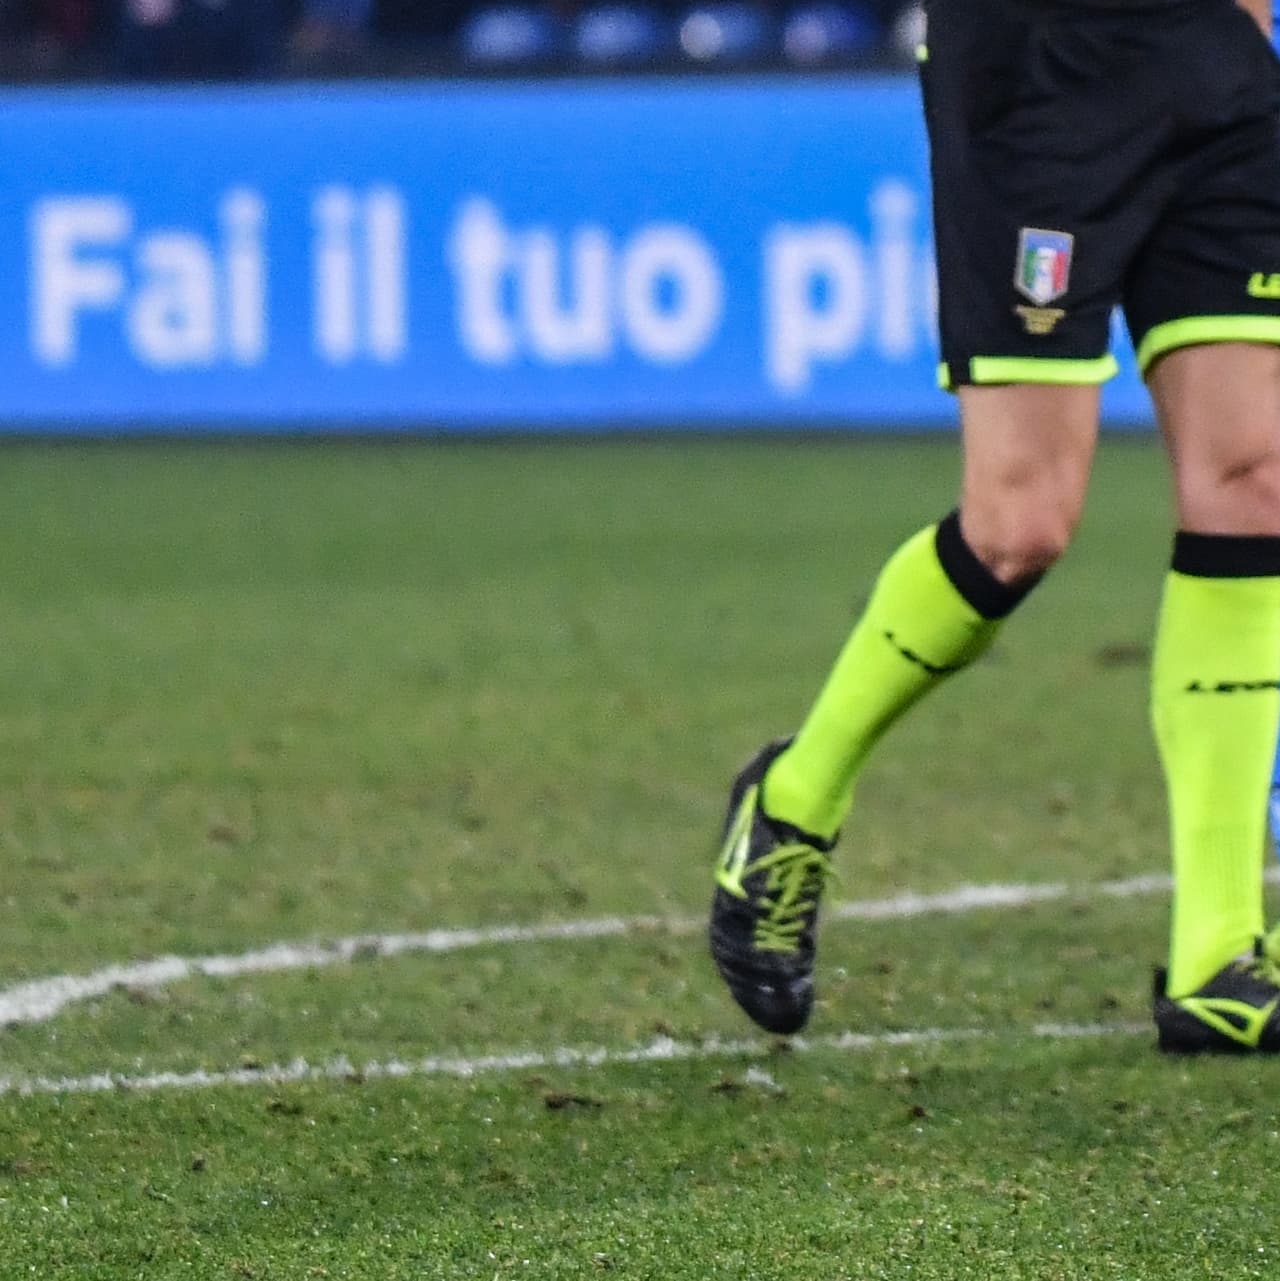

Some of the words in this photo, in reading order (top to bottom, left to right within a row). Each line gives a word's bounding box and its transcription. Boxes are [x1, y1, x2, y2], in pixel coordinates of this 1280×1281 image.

[31, 187, 268, 368] Fai
[313, 184, 406, 365] il
[451, 198, 724, 365] tuo
[763, 178, 940, 396] pi
